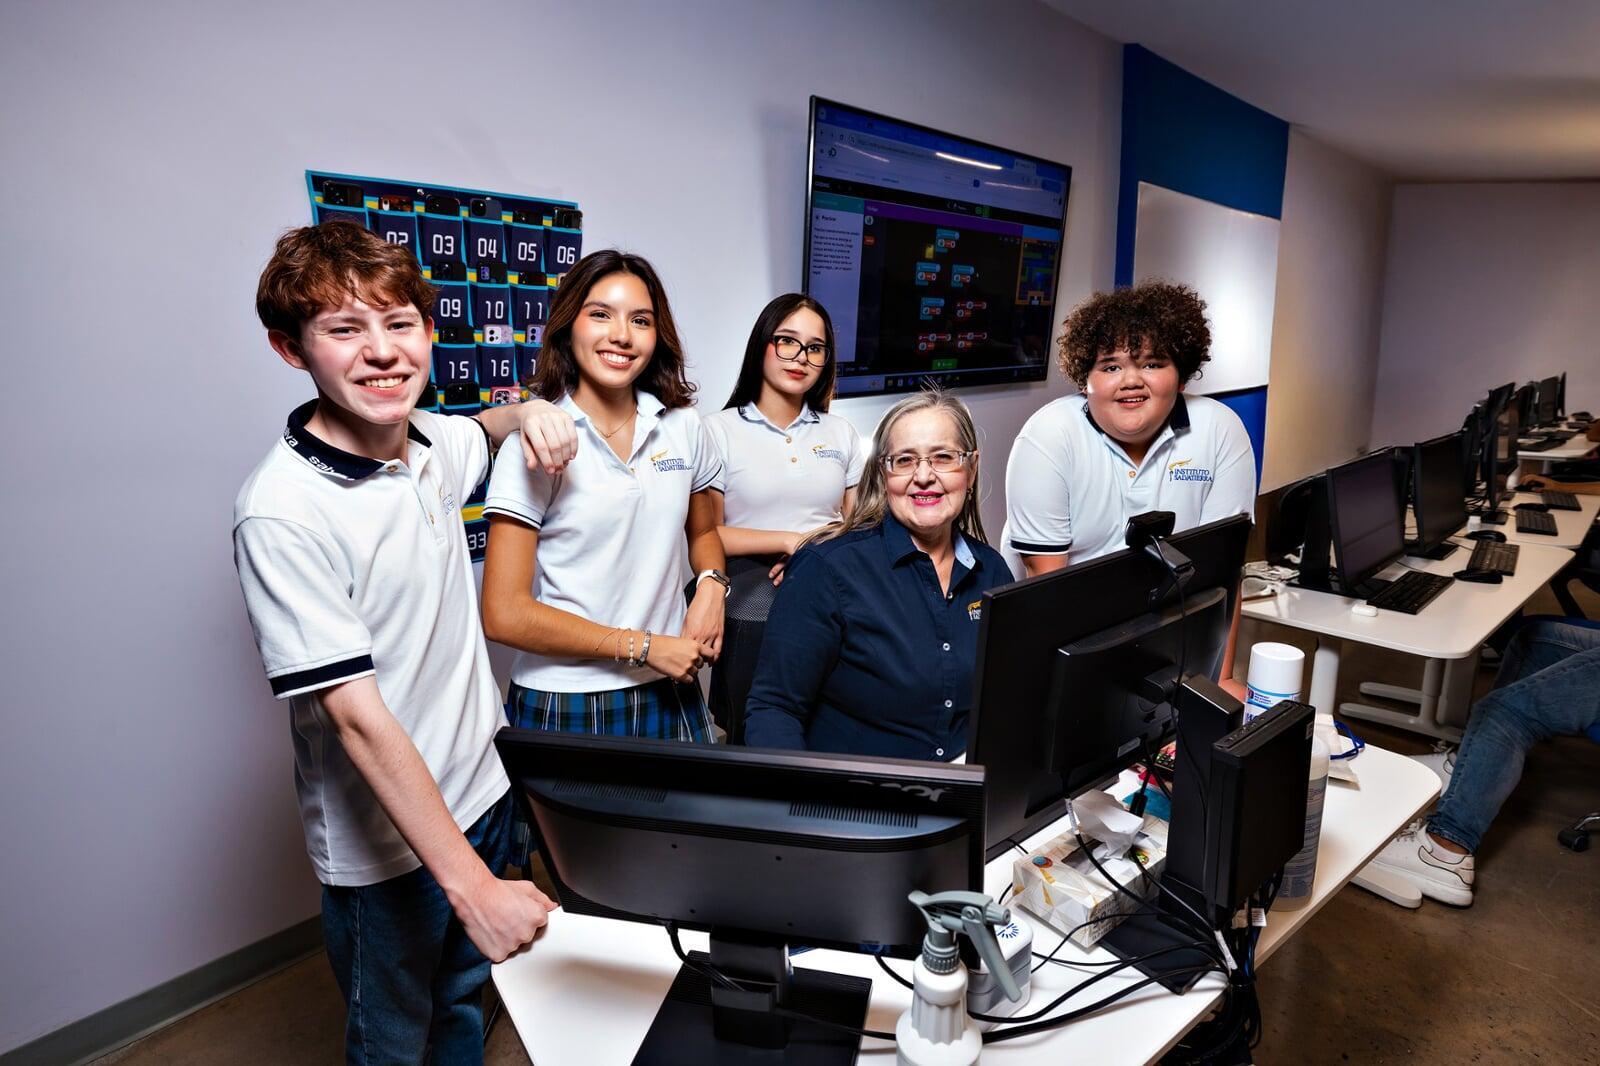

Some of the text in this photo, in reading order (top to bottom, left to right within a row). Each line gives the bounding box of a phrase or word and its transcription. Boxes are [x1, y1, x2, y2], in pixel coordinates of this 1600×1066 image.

[432, 234, 454, 255] 03
[477, 238, 497, 258] 04
[517, 242, 537, 261] 05
[556, 245, 576, 264] 06
[440, 298, 461, 318] 09
[485, 300, 504, 319] 10
[524, 302, 543, 320] 11
[448, 360, 469, 380] 15
[490, 359, 510, 377] 16
[1174, 468, 1210, 476] INSTITUTO
[467, 531, 487, 550] 33
